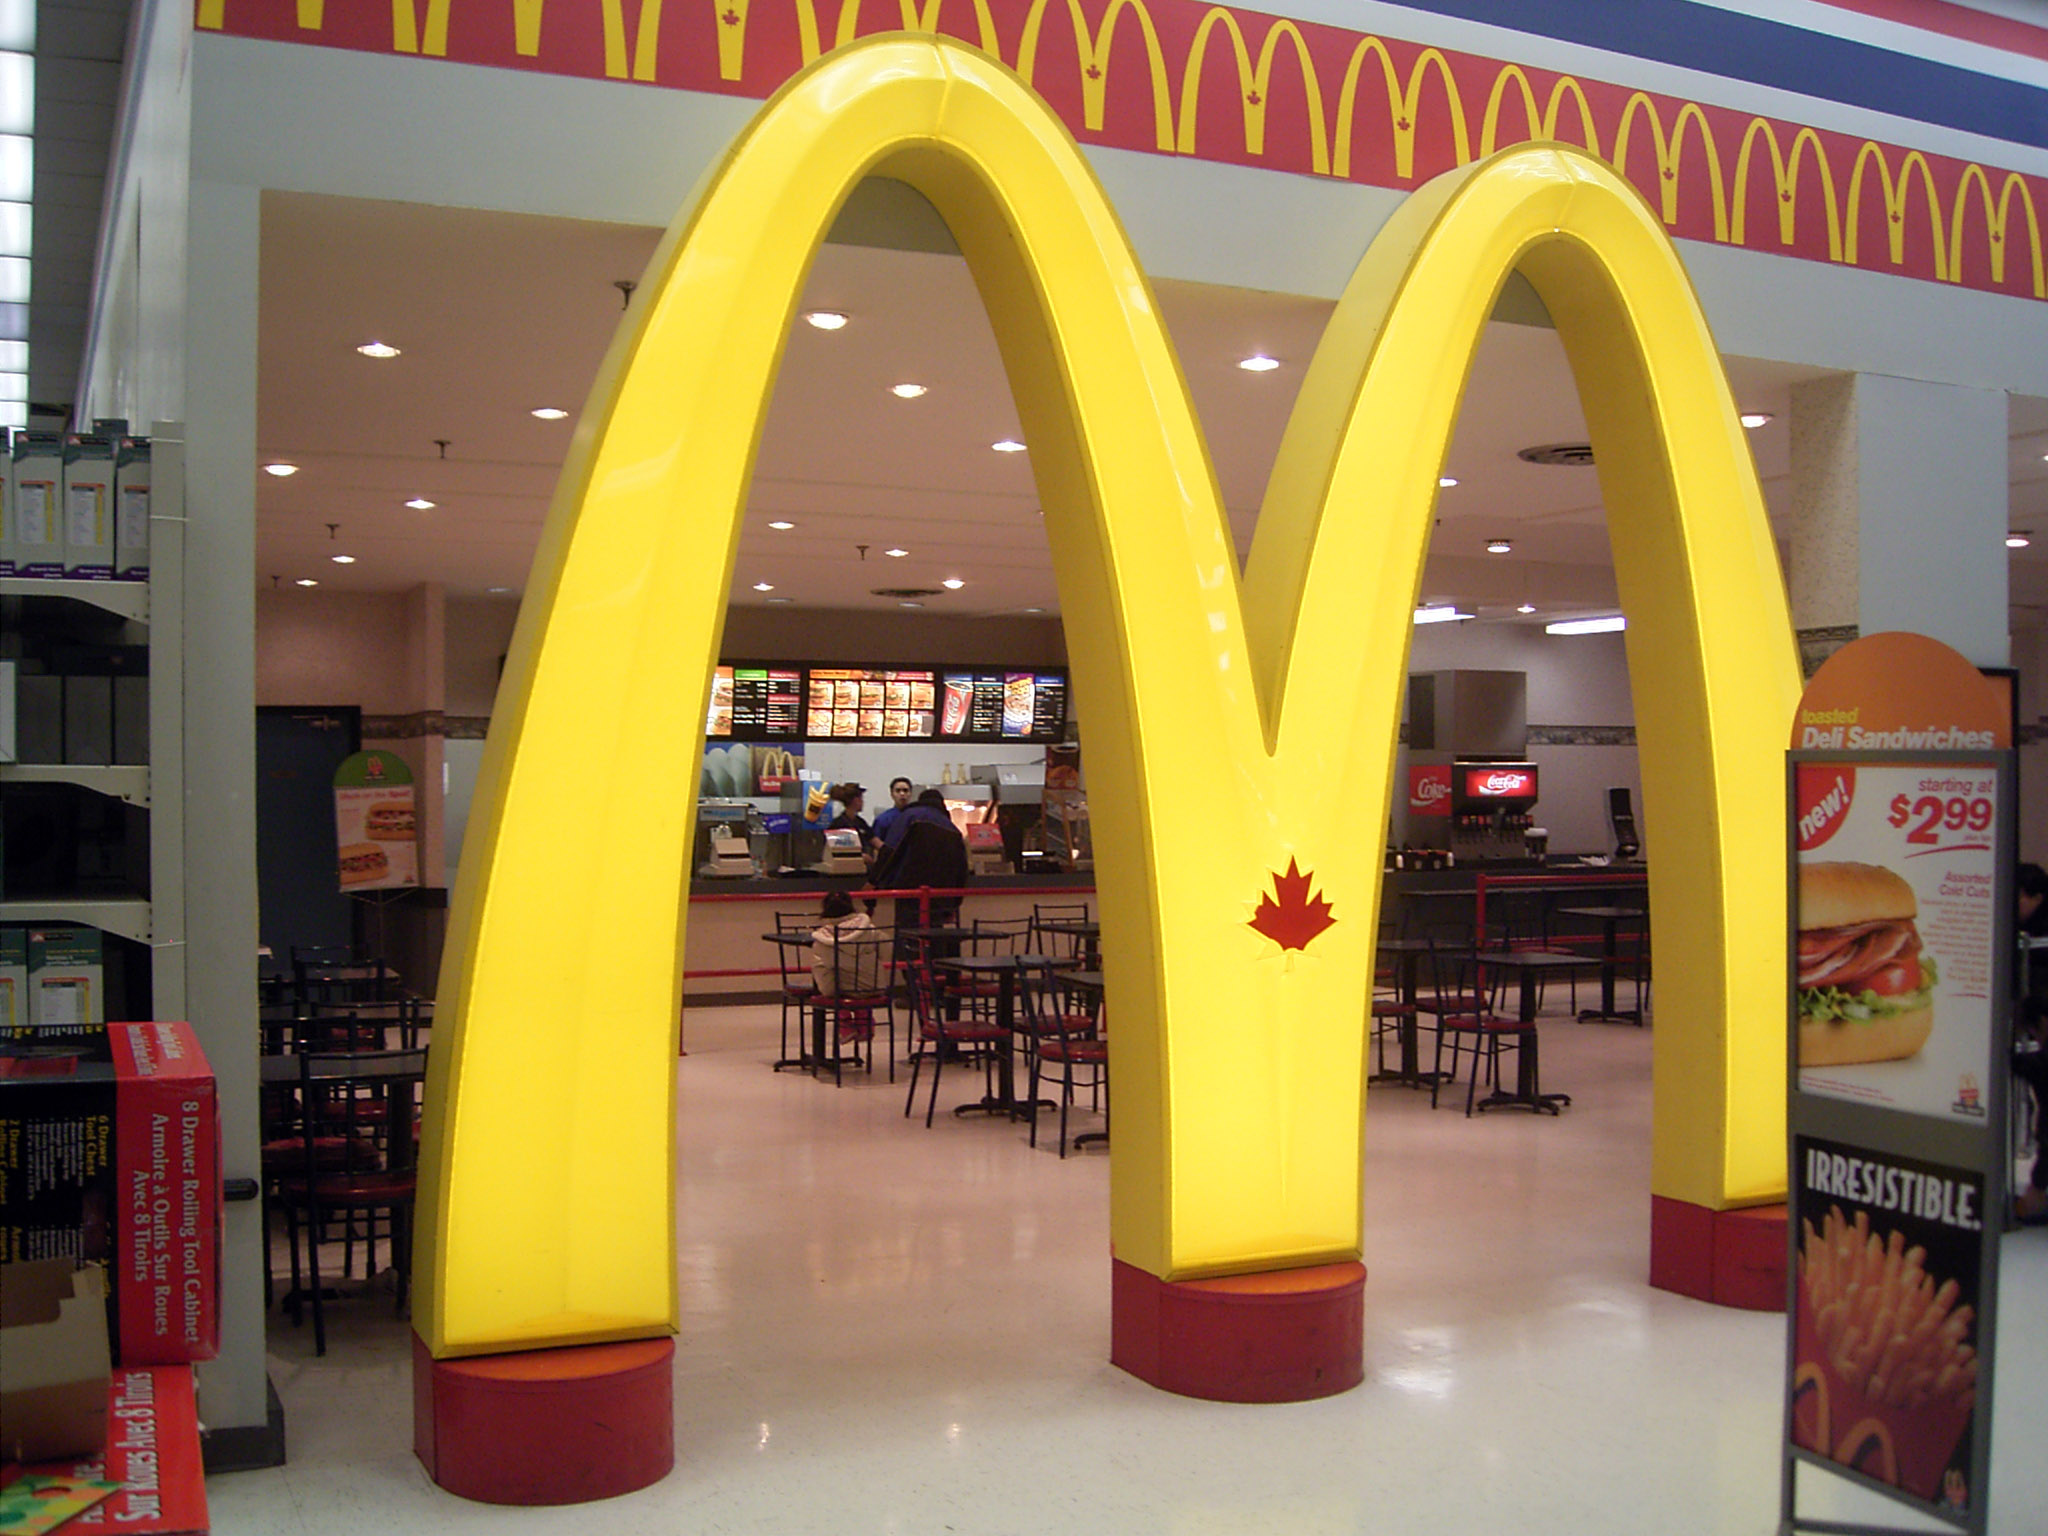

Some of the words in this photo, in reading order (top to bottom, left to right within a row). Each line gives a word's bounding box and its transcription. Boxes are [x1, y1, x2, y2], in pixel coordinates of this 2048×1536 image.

[1802, 707, 1859, 724] toasted
[1802, 726, 1843, 749] Deli
[1848, 726, 1995, 749] Sandwiches
[1918, 777, 1972, 796] starting
[1977, 779, 1993, 793] at
[1799, 776, 1849, 841] new!
[1938, 884, 1963, 896] Cold
[1966, 885, 1990, 898] Cuts
[1944, 870, 1992, 884] Assorted
[182, 1101, 199, 1112] 8
[99, 1126, 109, 1167] Drawer
[152, 1113, 169, 1181] Armoire
[182, 1116, 199, 1175] Drawer
[133, 1169, 150, 1209] Avec
[1807, 1149, 1982, 1231] IRRESISTIBLE.
[134, 1213, 151, 1225] 8
[152, 1199, 171, 1250] Outils
[179, 1179, 200, 1237] Rolling
[134, 1229, 152, 1282] Tiroirs
[153, 1254, 172, 1281] Sur
[183, 1239, 200, 1275] Tool
[154, 1285, 172, 1336] Roues
[184, 1278, 202, 1342] Cabinet
[114, 1408, 155, 1418] 8
[115, 1419, 156, 1449] Avec
[120, 1451, 159, 1490] Roues
[114, 1493, 162, 1521] Sur
